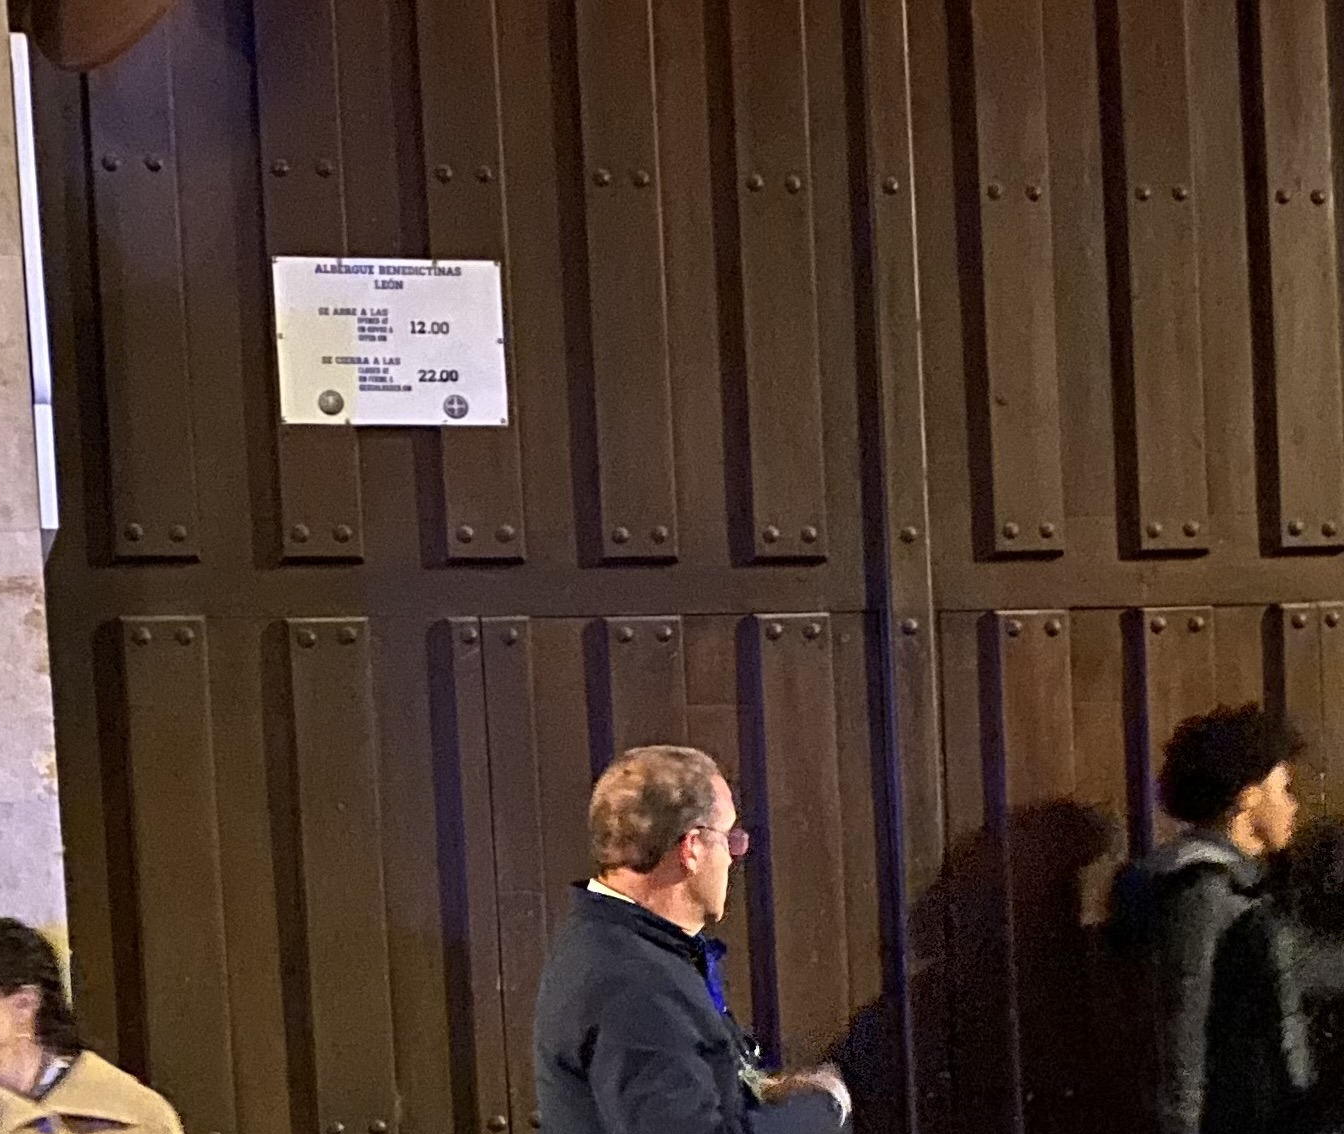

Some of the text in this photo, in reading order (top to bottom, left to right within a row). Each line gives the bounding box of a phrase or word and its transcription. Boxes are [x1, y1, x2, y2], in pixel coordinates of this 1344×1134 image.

[314, 264, 462, 277] ALBERGUE BENEDICTINAS
[374, 278, 404, 290] LEÓN
[410, 320, 450, 335] 12.00
[418, 369, 459, 383] 22.00
